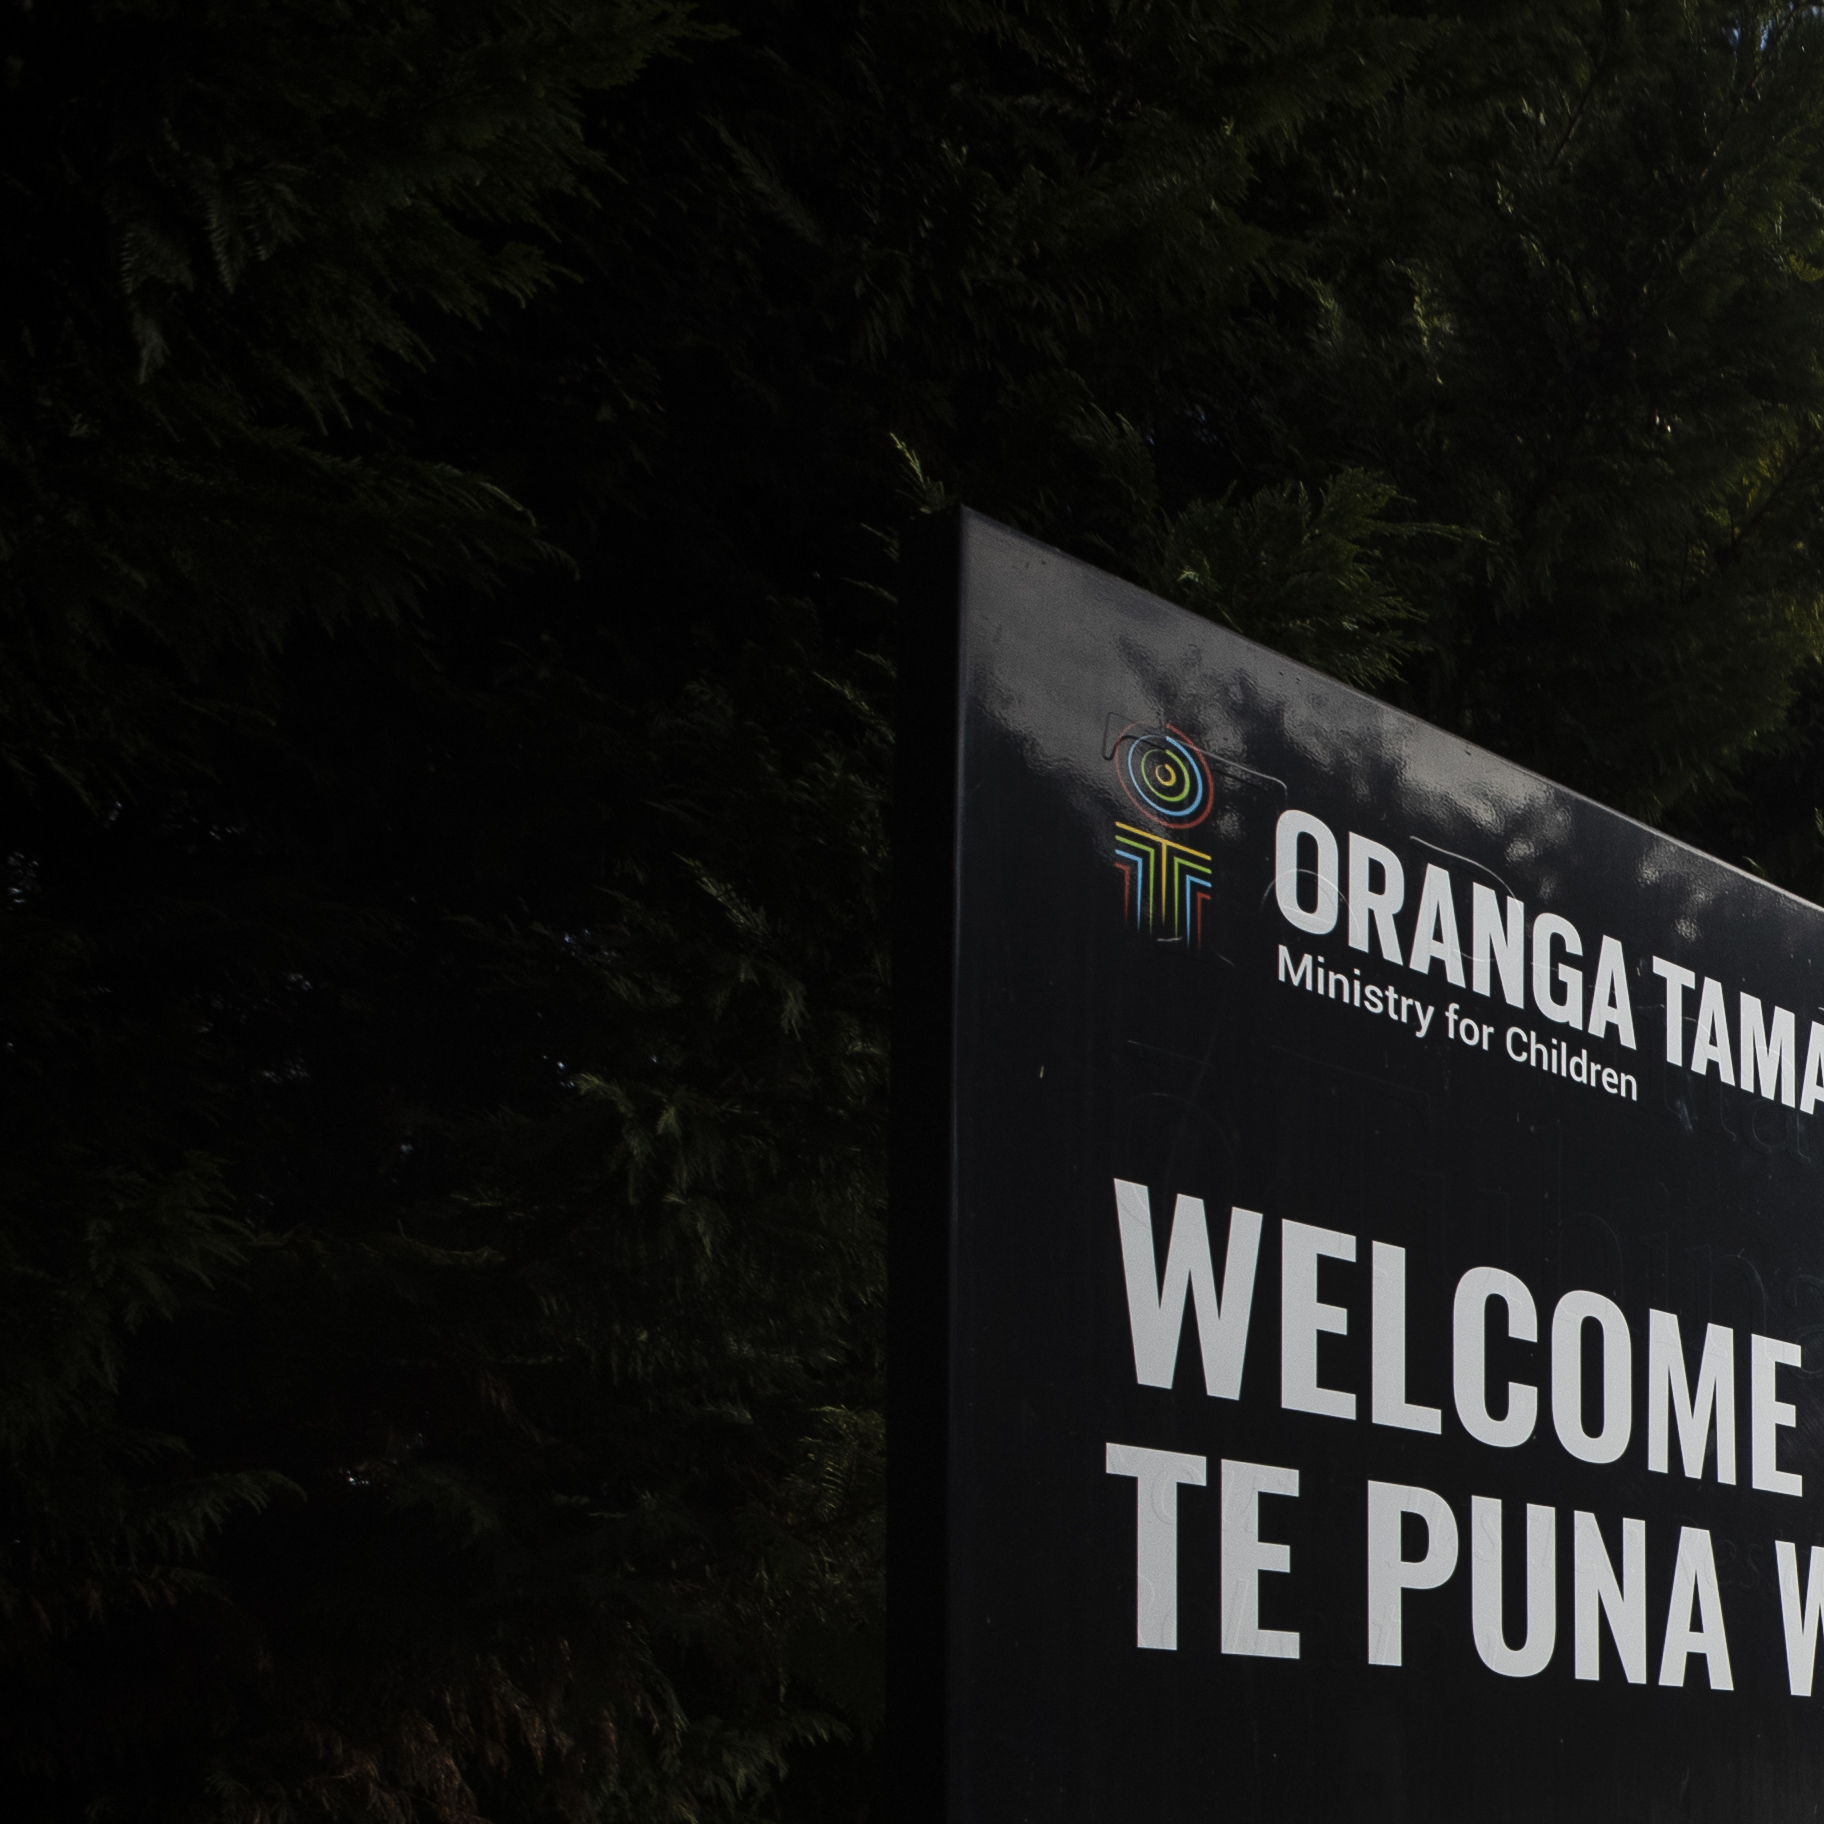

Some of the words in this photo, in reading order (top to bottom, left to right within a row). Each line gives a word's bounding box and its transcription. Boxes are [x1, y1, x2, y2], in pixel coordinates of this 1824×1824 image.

[1274, 808, 1637, 1051] ORANGA
[1278, 944, 1435, 1038] Ministry
[1444, 1002, 1495, 1051] for
[1505, 1026, 1638, 1102] Children
[1113, 1178, 1803, 1498] WELCOME
[1105, 1442, 1300, 1660] TE
[1367, 1479, 1735, 1692] PUNA
